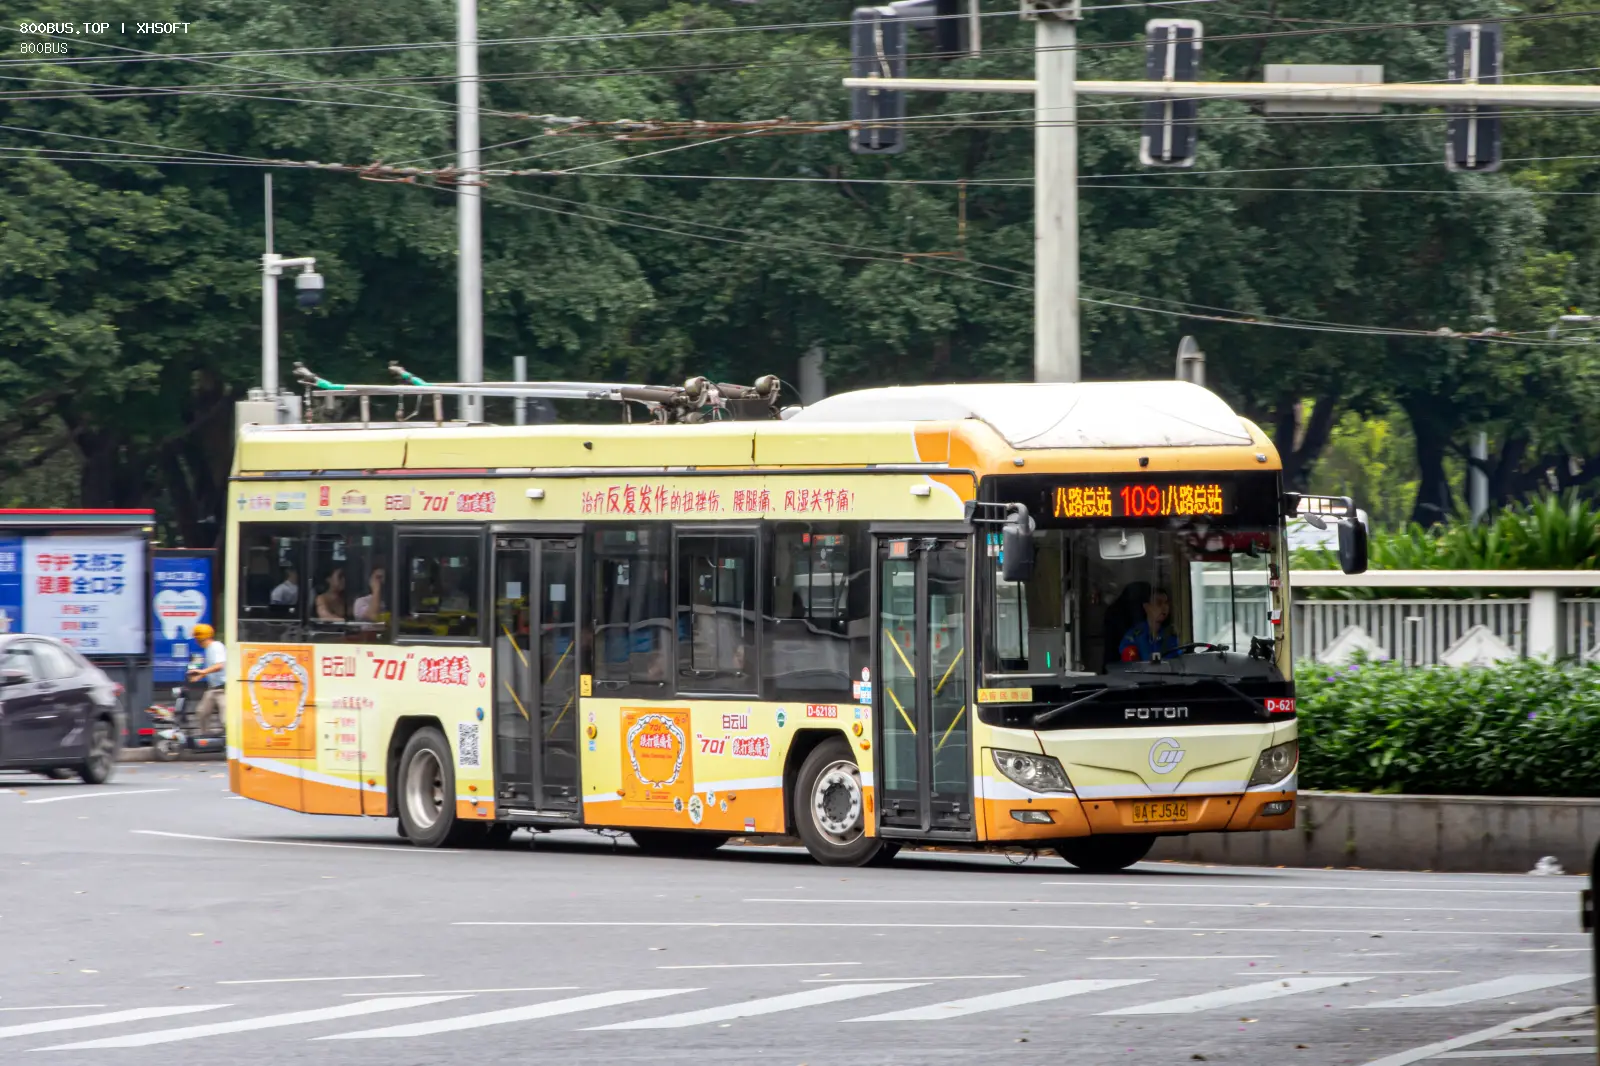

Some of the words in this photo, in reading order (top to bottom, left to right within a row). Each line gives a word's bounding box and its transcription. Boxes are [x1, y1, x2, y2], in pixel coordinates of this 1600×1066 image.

[1054, 486, 1112, 517] 八路总站
[1120, 485, 1161, 517] 109
[321, 655, 357, 677] 白云山
[807, 704, 837, 718] D-62188
[1124, 706, 1188, 720] FOTON
[1267, 699, 1296, 712] D-621
[721, 713, 748, 730] 白云山
